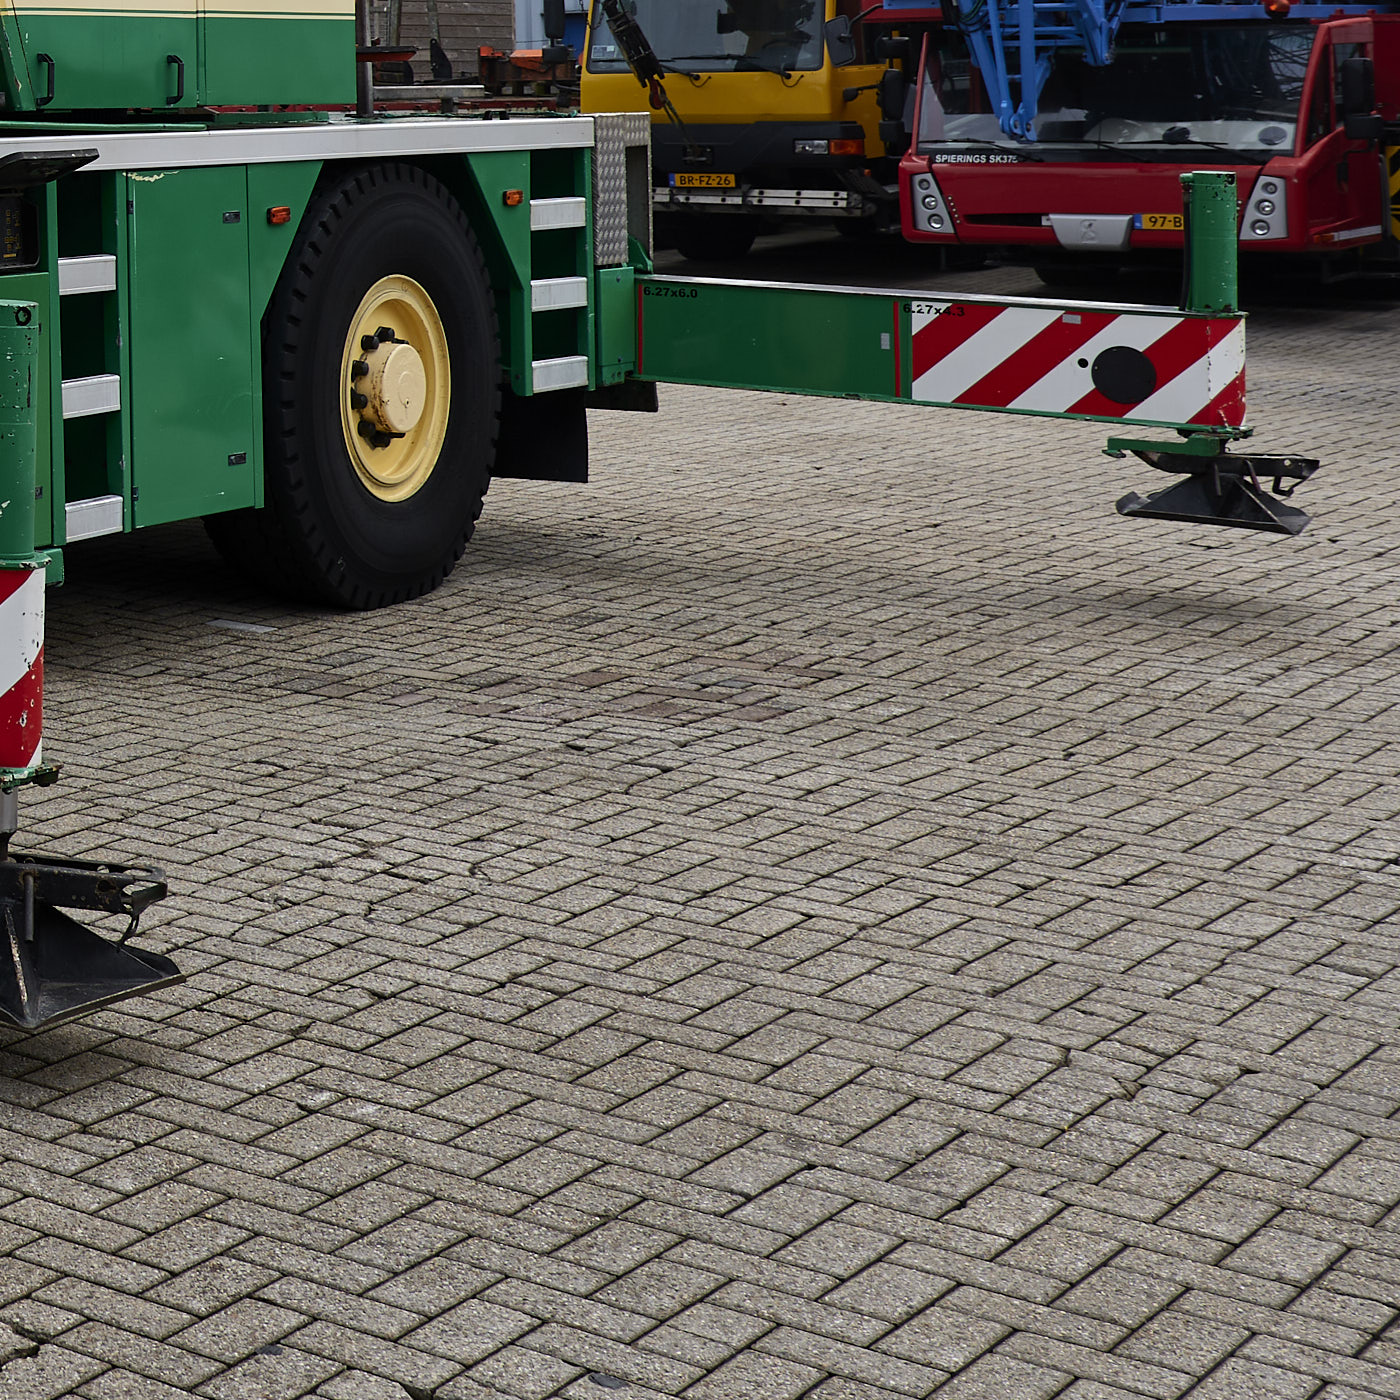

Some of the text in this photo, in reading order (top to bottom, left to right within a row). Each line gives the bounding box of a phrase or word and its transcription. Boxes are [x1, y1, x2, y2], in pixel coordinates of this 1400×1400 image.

[935, 154, 987, 163] SPIERINGS
[679, 175, 731, 185] BR-FZ-26
[643, 286, 698, 298] 6.27x6.0
[903, 303, 965, 317] 6.27x4.3
